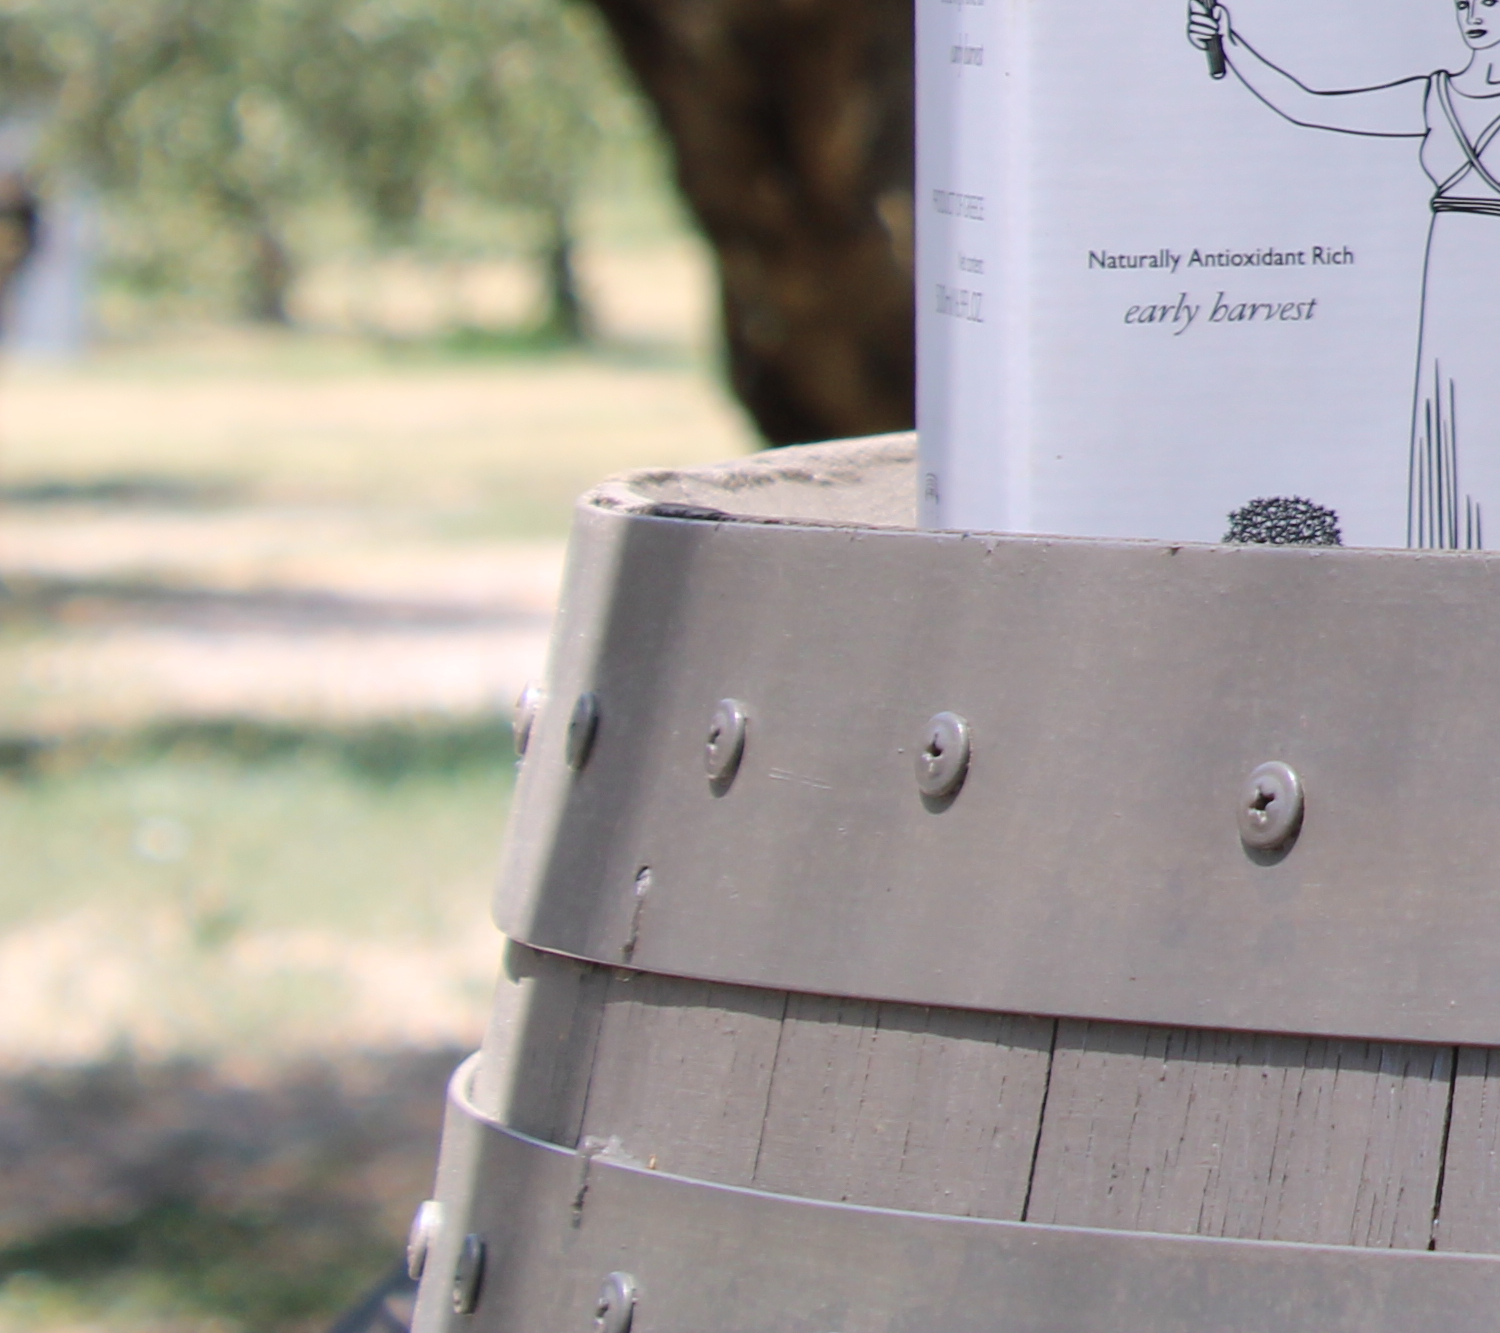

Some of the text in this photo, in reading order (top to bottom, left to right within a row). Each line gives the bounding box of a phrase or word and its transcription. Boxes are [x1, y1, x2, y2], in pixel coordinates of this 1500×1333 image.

[1089, 245, 1355, 274] Naturally Antioxidant Rich
[1124, 292, 1317, 335] early harvest
